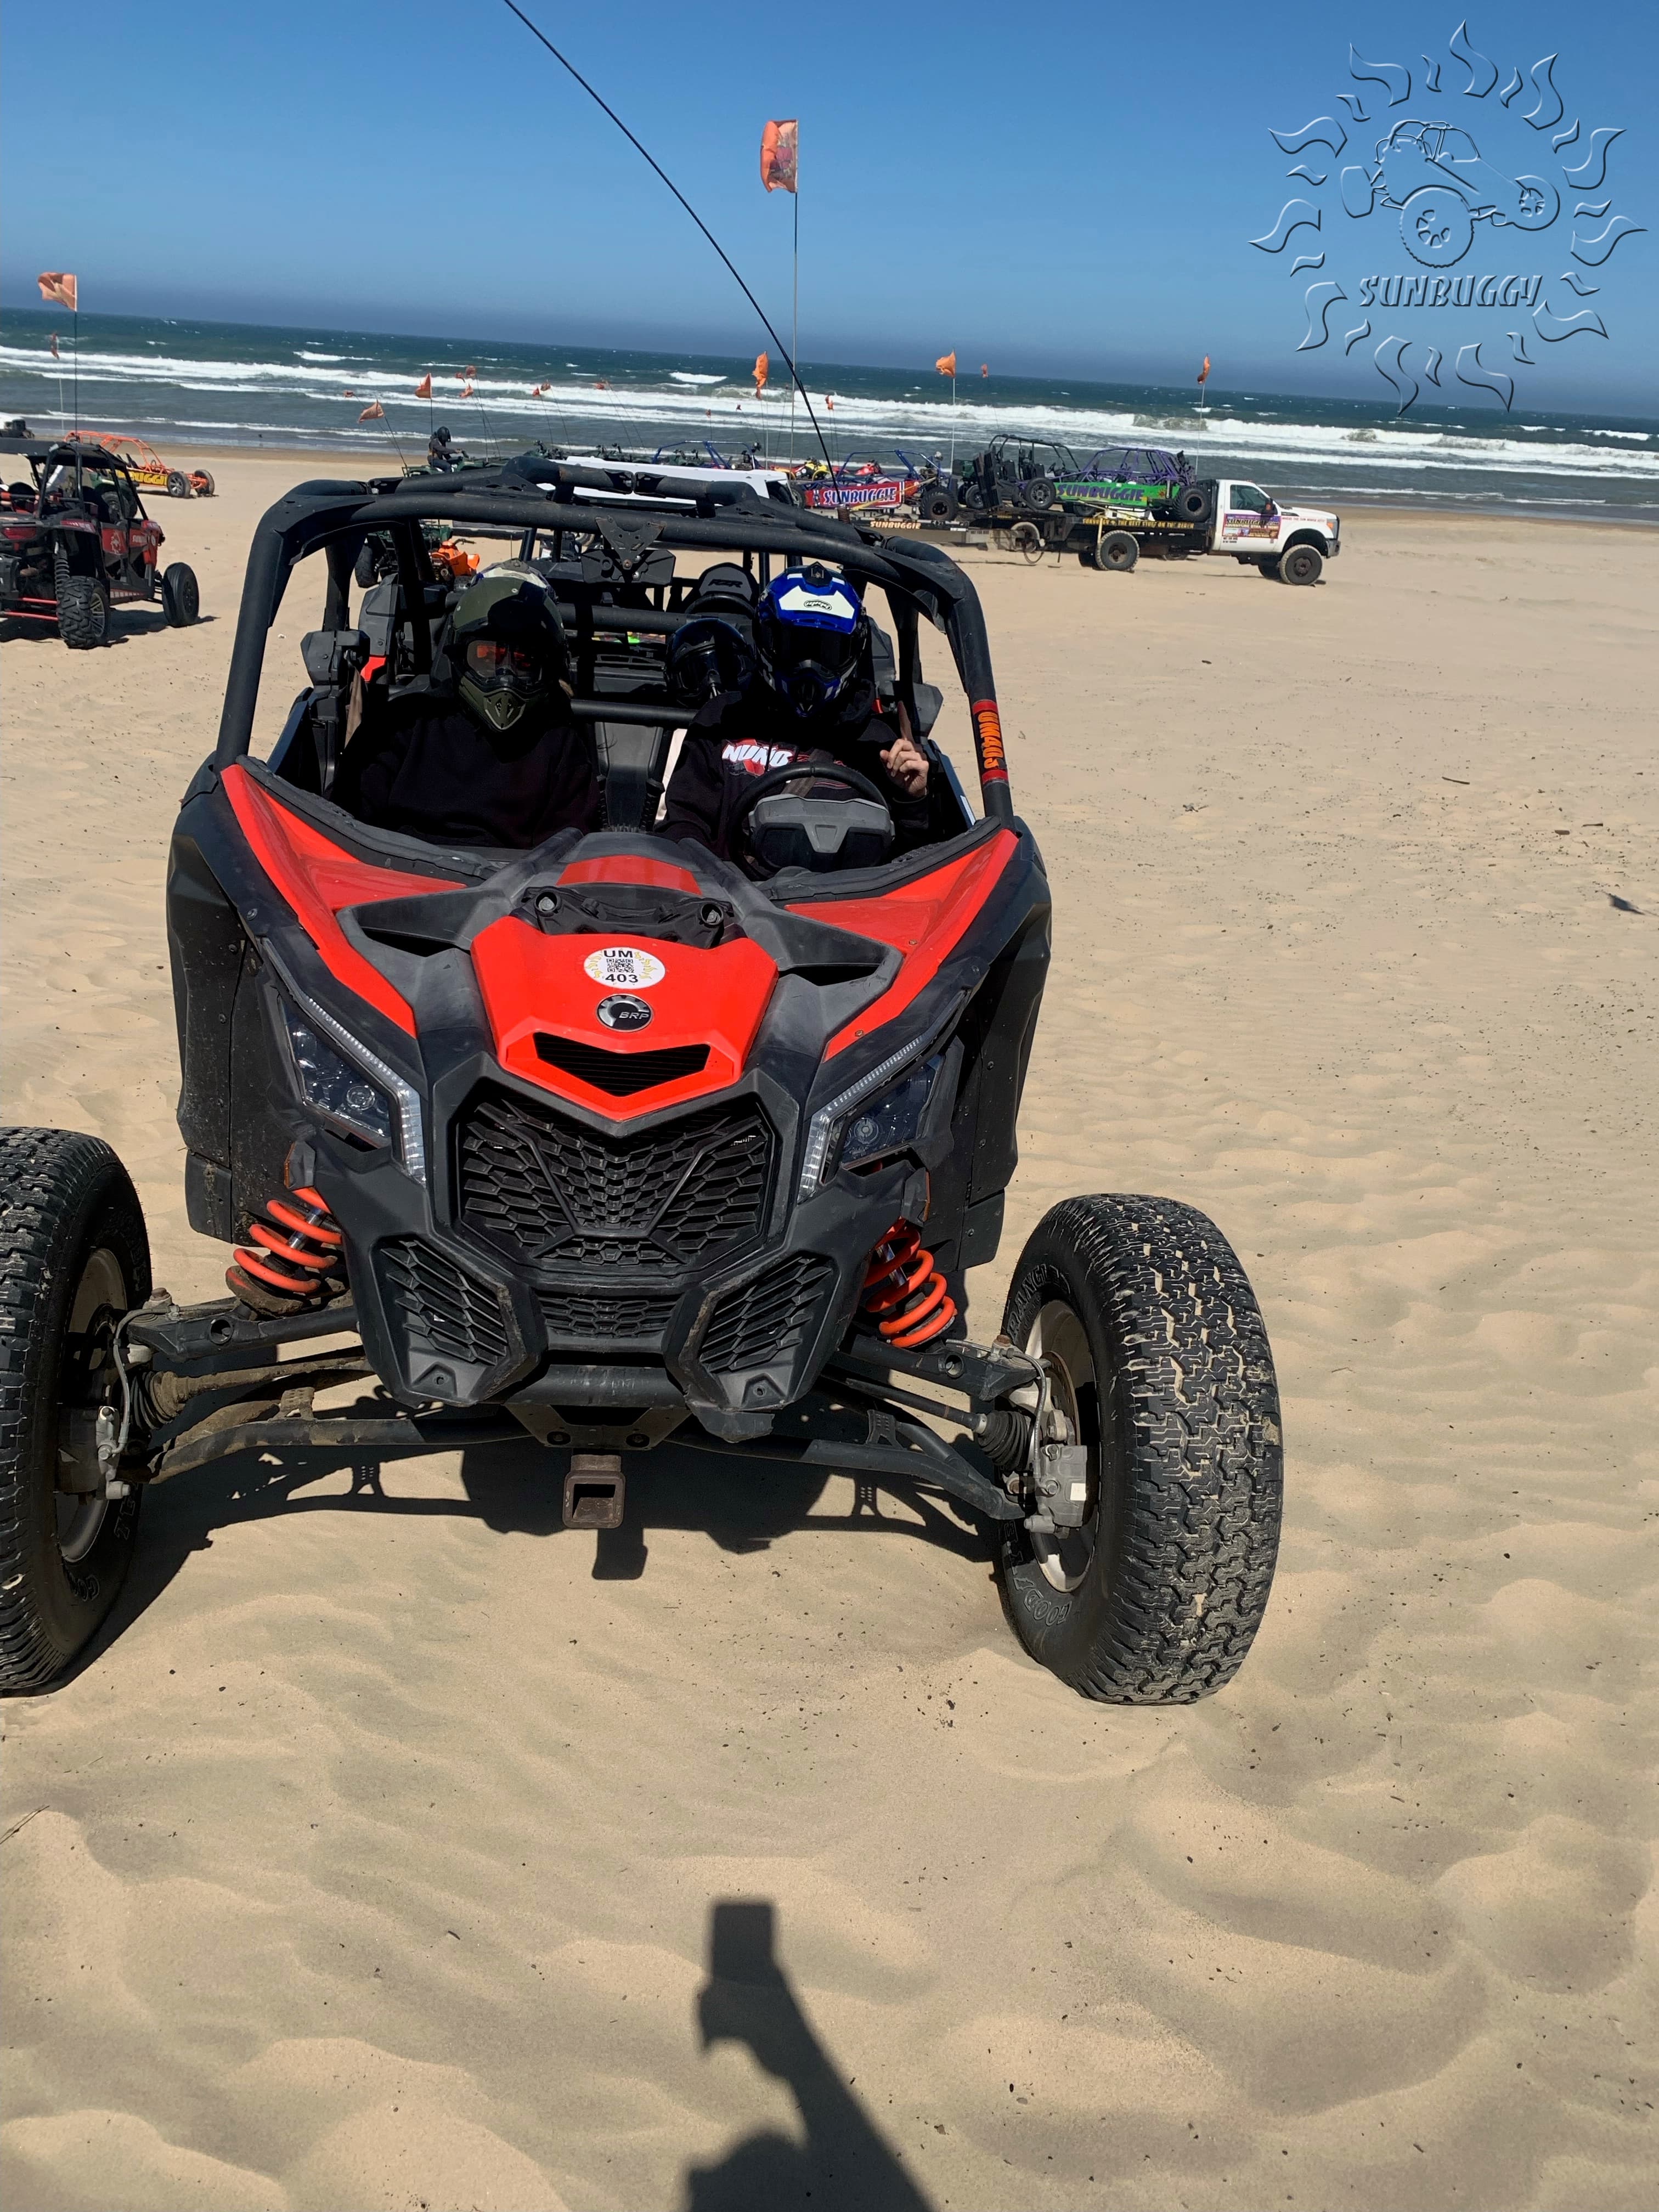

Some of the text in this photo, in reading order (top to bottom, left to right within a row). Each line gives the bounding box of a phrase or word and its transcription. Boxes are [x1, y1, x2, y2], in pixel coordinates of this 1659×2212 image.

[823, 487, 897, 505] SUNBUGGIE
[1057, 483, 1145, 501] SUNBUGGIE
[870, 521, 921, 529] SUNBUGGIE
[708, 579, 743, 588] RZR
[605, 974, 639, 983] 403
